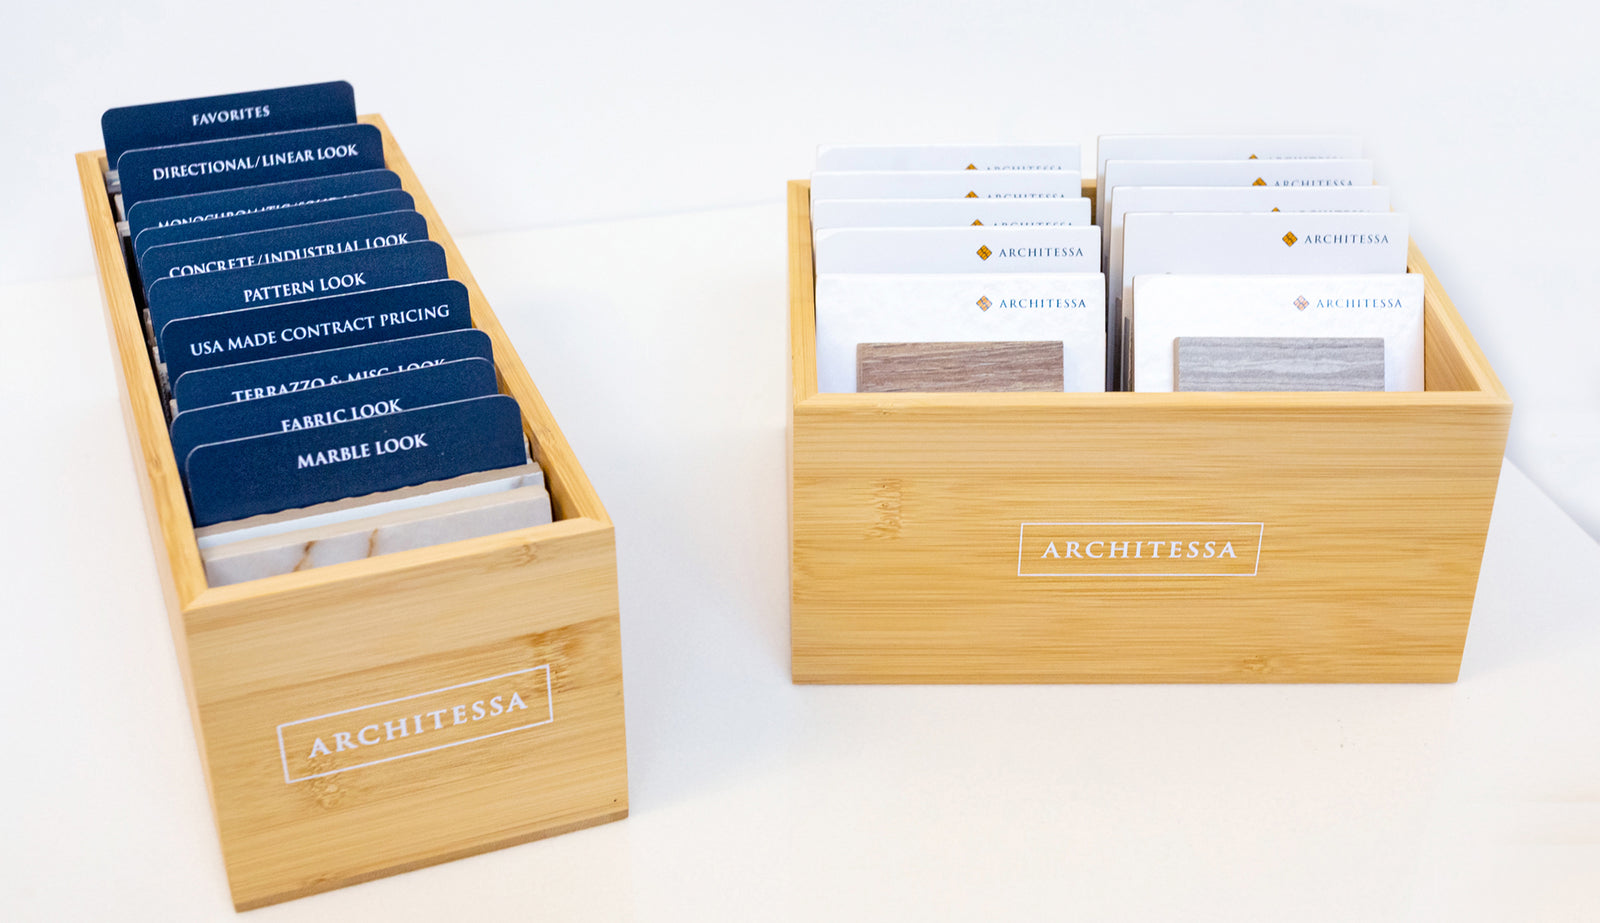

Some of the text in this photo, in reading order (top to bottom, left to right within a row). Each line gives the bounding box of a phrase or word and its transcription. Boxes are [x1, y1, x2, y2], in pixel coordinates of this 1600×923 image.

[191, 104, 271, 127] FAVORITES
[152, 143, 359, 181] DIRECTIONAL/LINEAR LOOK
[365, 232, 408, 249] LOOK
[1304, 233, 1390, 245] ARCHITESSA
[999, 246, 1084, 258] ARCHITESSA
[243, 272, 366, 303] PATTERN LOOK
[999, 298, 1088, 309] ARCHITESSA
[1316, 298, 1403, 309] ARCHITESSA
[190, 304, 451, 357] USA MADE CONTRACT PRICING
[280, 398, 403, 433] FABRIC LOOK
[297, 432, 429, 470] MARBLE LOOK
[1041, 540, 1238, 559] ARCHITESSA
[307, 691, 529, 760] ARCHITESSA
